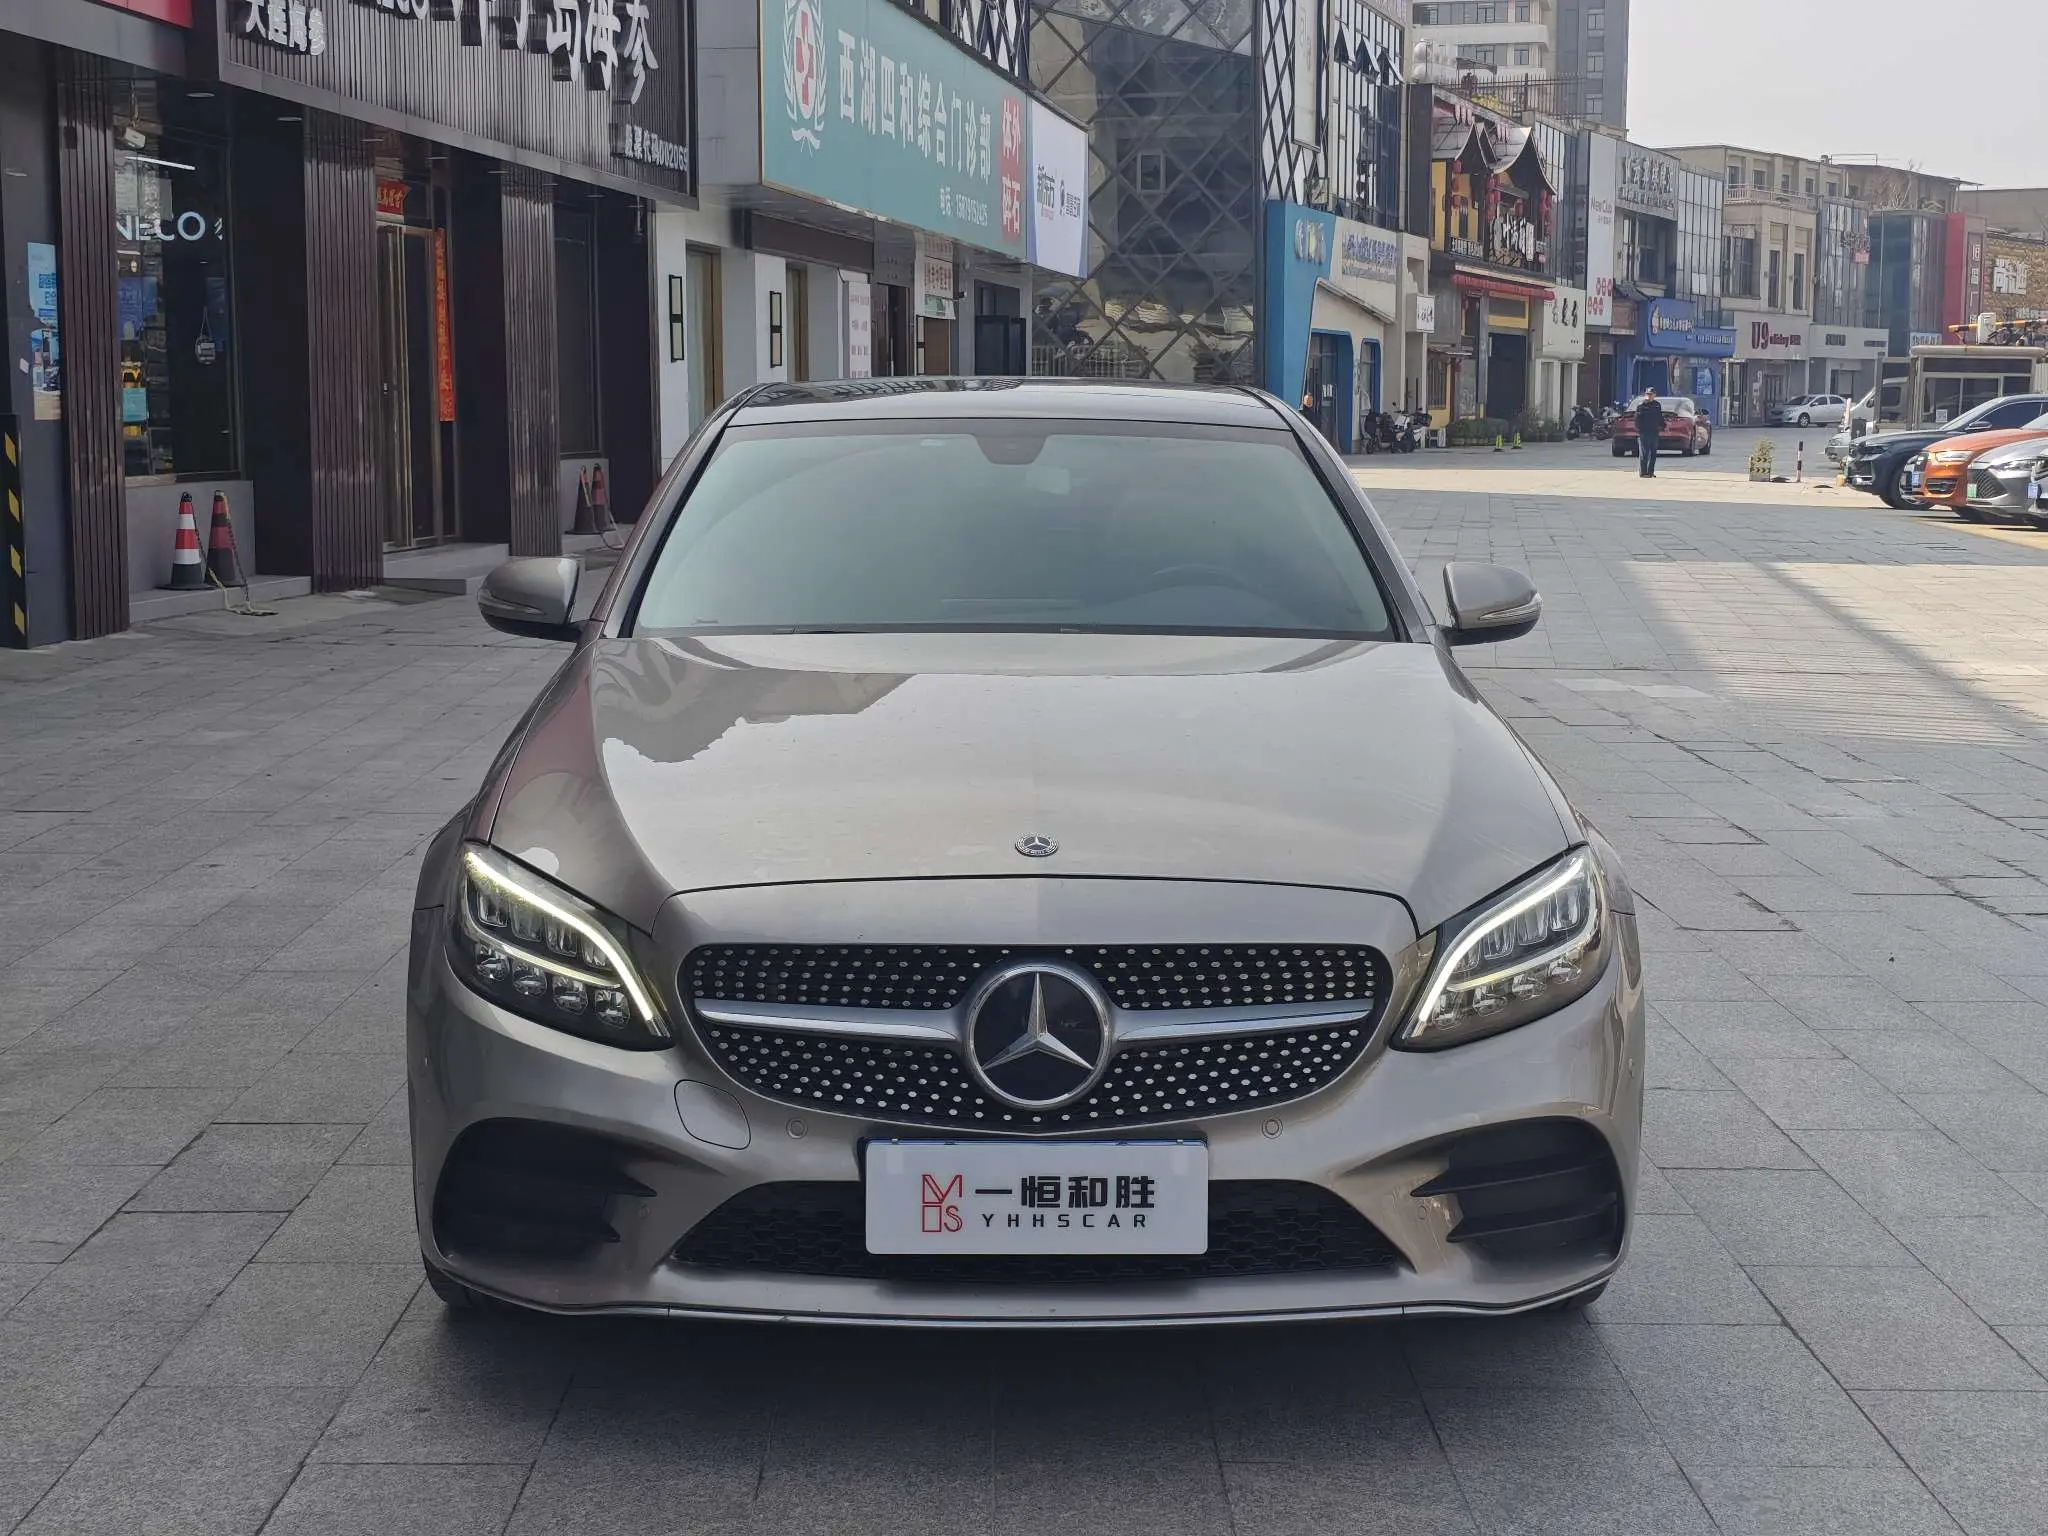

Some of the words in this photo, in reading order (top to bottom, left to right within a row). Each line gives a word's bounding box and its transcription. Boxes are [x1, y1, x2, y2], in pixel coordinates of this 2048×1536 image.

[838, 29, 991, 185] 西湖四和综合门诊部
[1002, 98, 1021, 165] 体外
[974, 1175, 1155, 1209] 一恒和胜
[982, 1213, 1147, 1228] YHHSCAR
